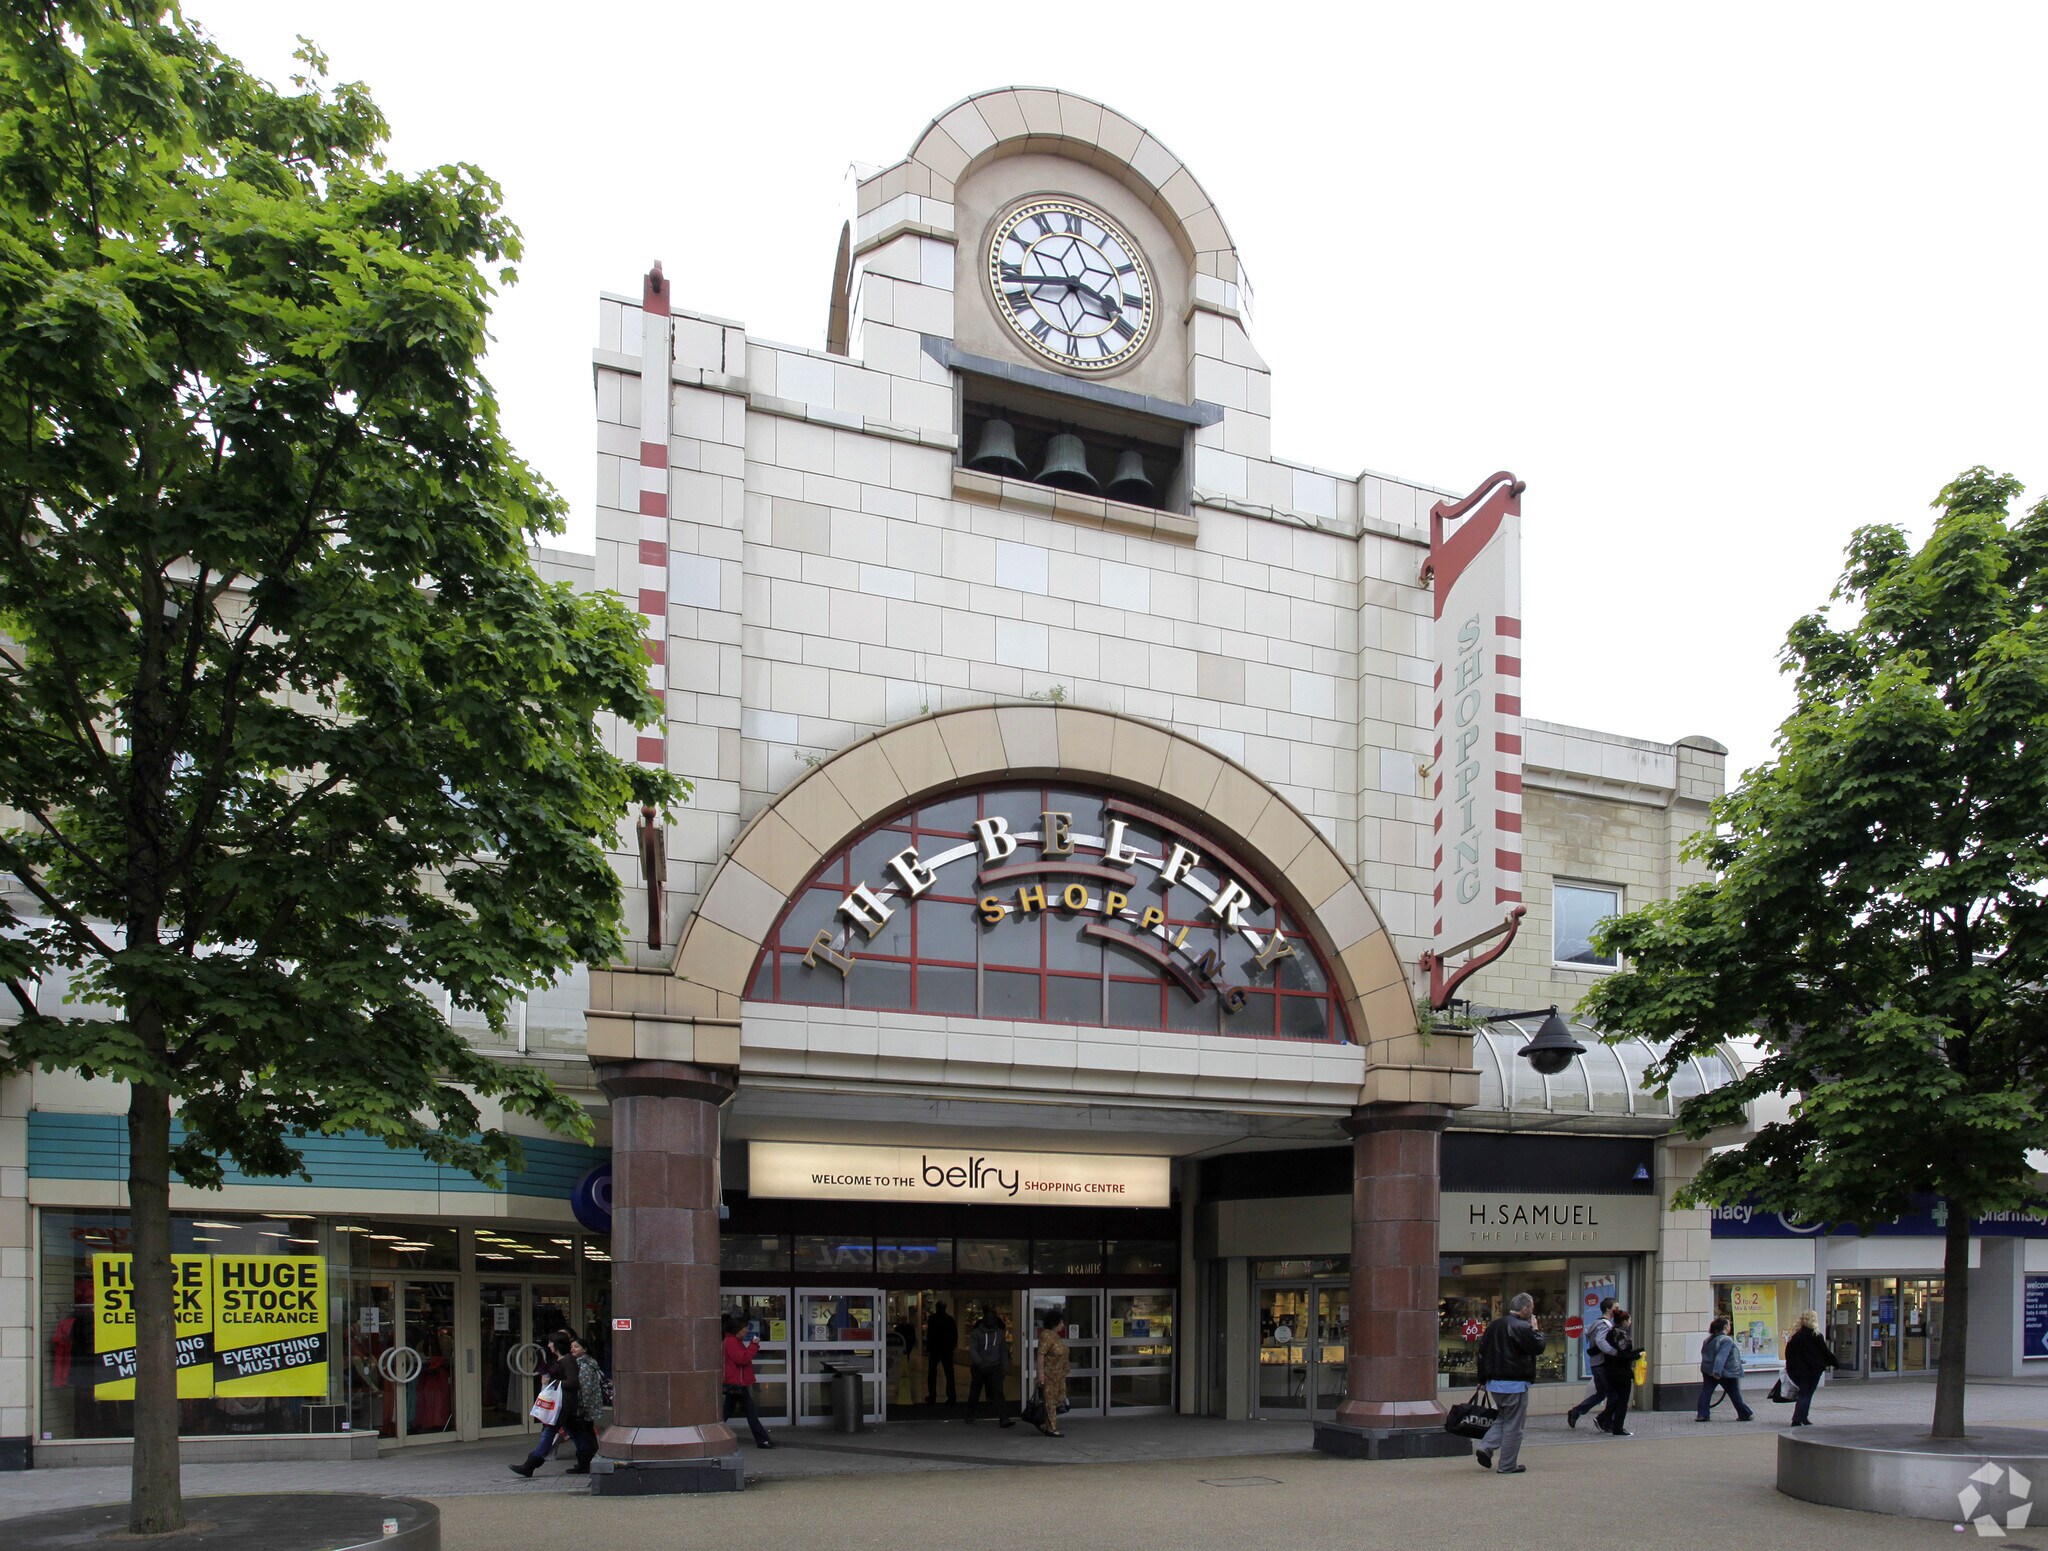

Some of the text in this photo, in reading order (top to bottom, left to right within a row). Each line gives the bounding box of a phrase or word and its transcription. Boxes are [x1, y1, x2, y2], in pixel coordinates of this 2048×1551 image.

[1453, 613, 1483, 906] SHOPPING
[802, 811, 1296, 978] THE BELFRY
[978, 882, 1251, 1014] SHOPPING
[811, 1155, 1125, 1197] WELCOME TO THE belfry SHOPPING CENTRE
[1469, 1205, 1598, 1225] H.SAMUEL
[1470, 1232, 1598, 1243] THE JEWELLER
[103, 1262, 202, 1287] HE
[223, 1263, 317, 1288] HUGE
[223, 1290, 317, 1310] STOCK
[1734, 1293, 1741, 1305] 3
[1752, 1293, 1758, 1304] 2
[103, 1312, 203, 1324] CLENCE
[223, 1312, 318, 1324] CLEARANCE
[103, 1337, 205, 1367] EVEING
[223, 1337, 320, 1365] EVERYTHING
[238, 1351, 312, 1375] MUST GO!
[1461, 1415, 1495, 1428] ADIDA
